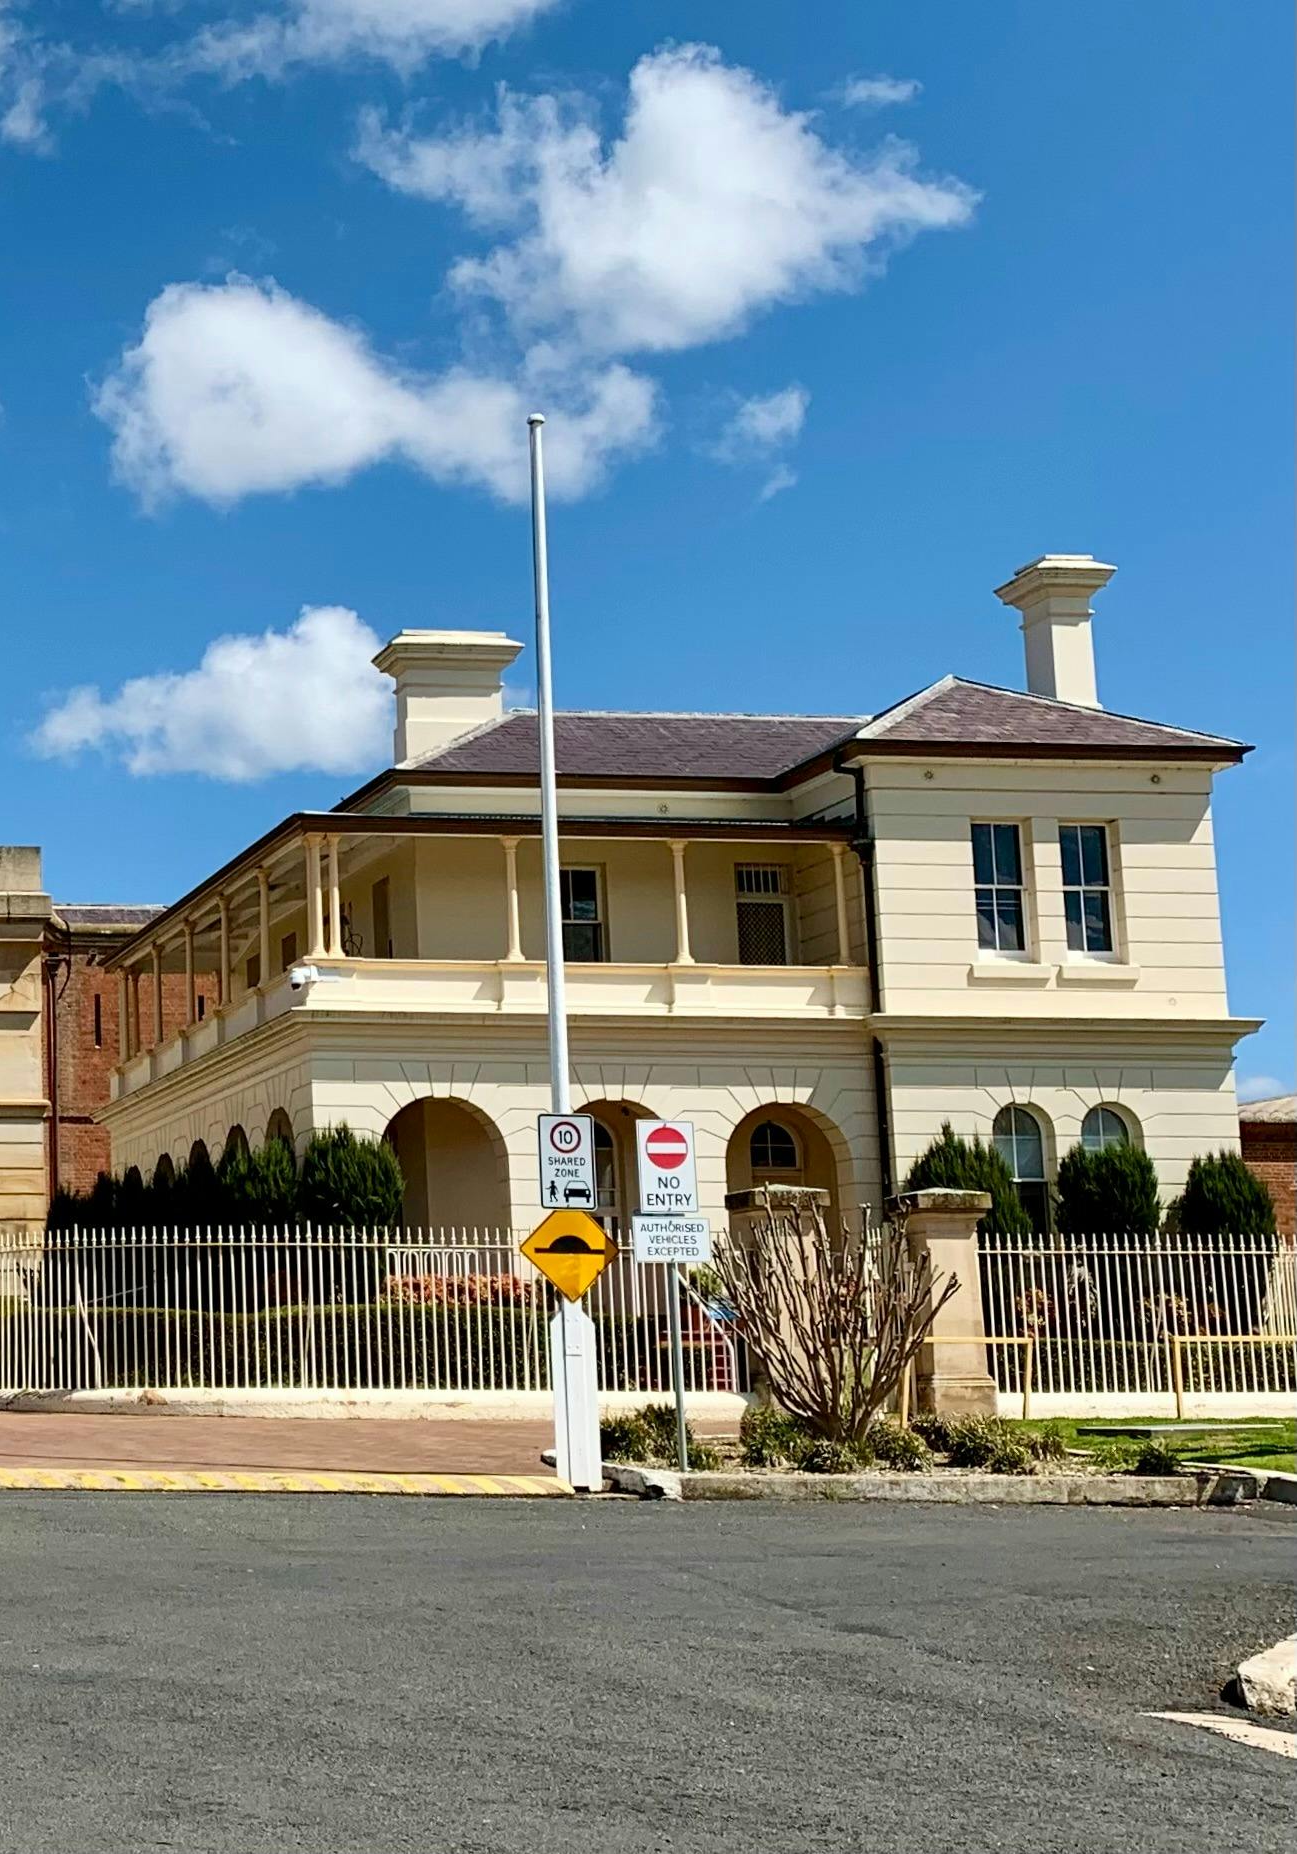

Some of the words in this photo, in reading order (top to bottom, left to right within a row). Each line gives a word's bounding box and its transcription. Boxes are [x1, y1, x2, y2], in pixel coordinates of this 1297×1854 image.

[558, 1130, 573, 1145] 10
[548, 1156, 586, 1166] SHARED
[554, 1168, 580, 1178] ZONE
[657, 1176, 680, 1189] NO
[646, 1193, 692, 1206] ENTRY
[640, 1223, 705, 1233] AUTHORISED
[649, 1235, 697, 1244] VEHICLES
[647, 1246, 699, 1256] EXCEPTED
